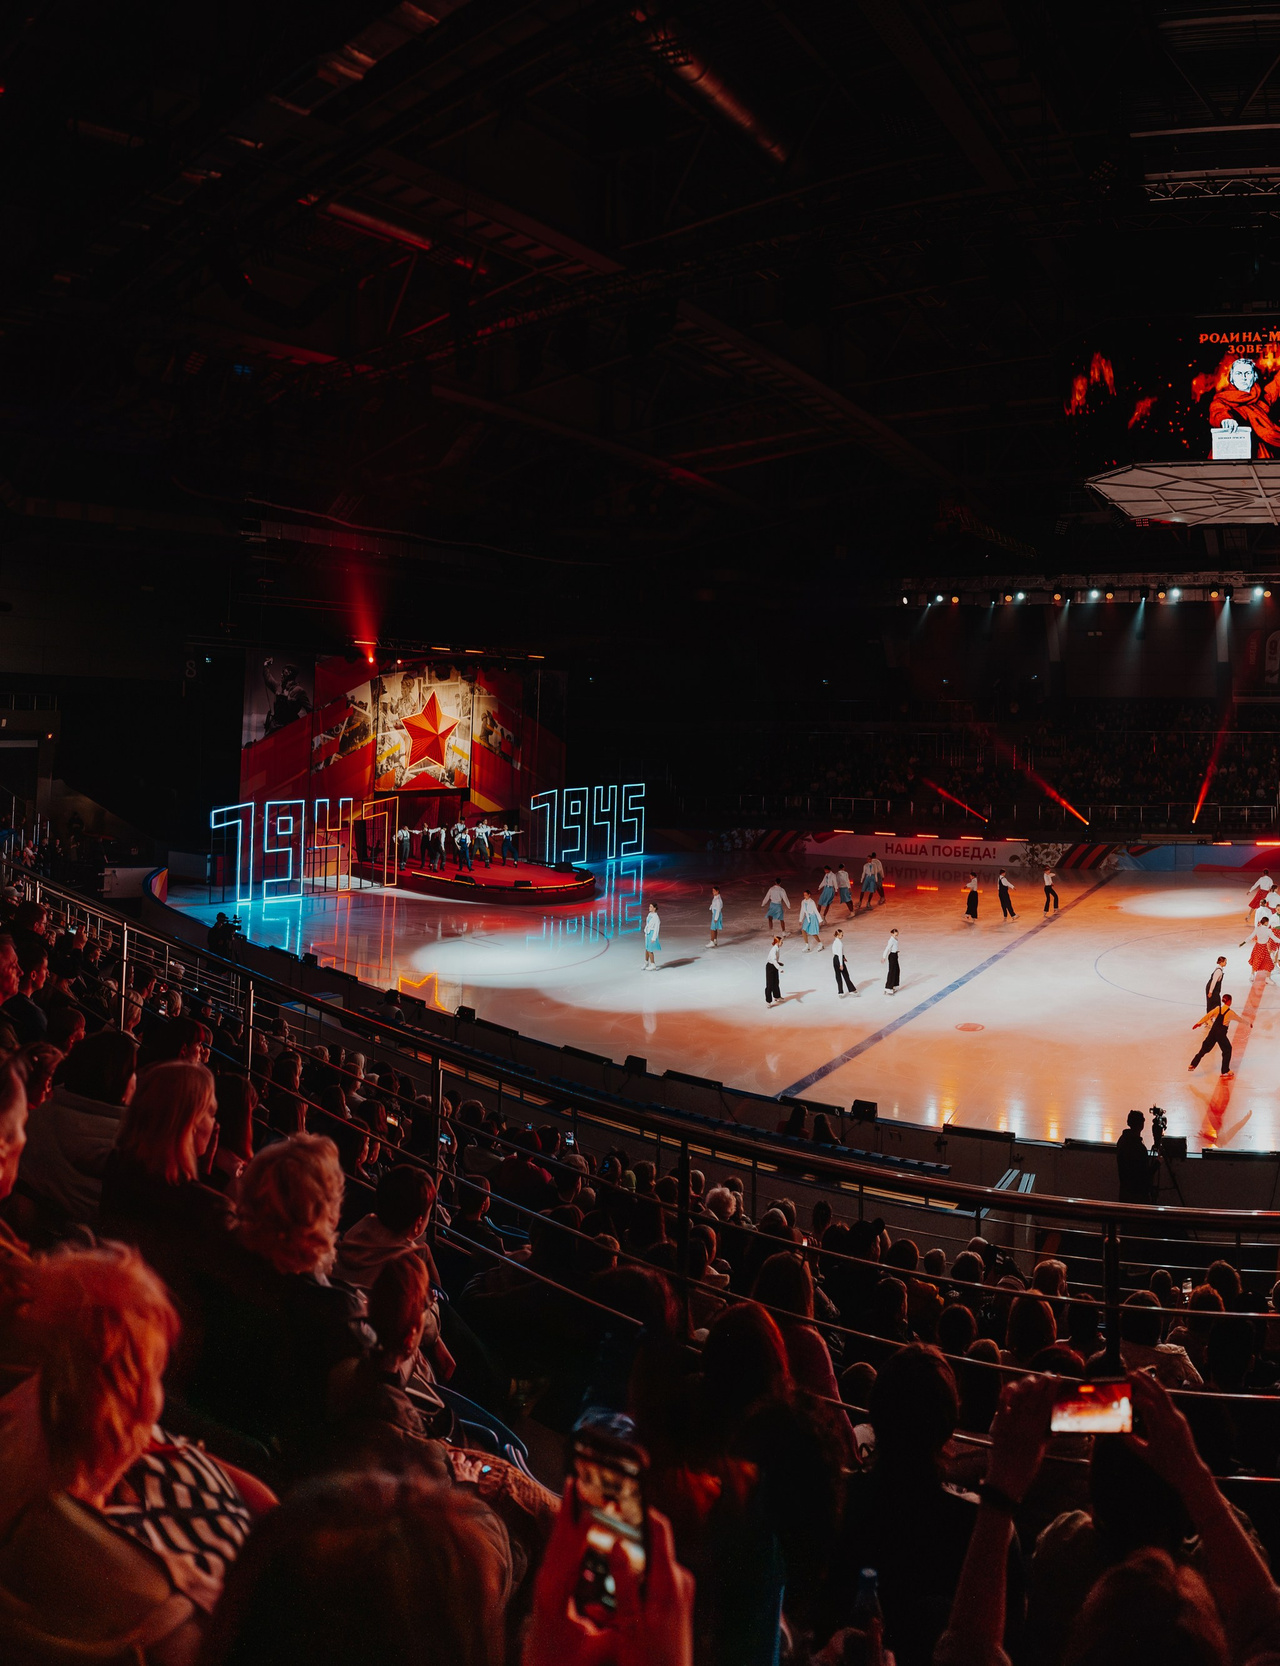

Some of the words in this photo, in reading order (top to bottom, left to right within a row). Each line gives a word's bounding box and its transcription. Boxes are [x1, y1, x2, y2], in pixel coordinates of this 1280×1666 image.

[210, 795, 400, 902] 1941
[530, 783, 646, 865] 1945
[885, 843, 928, 856] НАША
[932, 845, 996, 861] ПОБЕДА!
